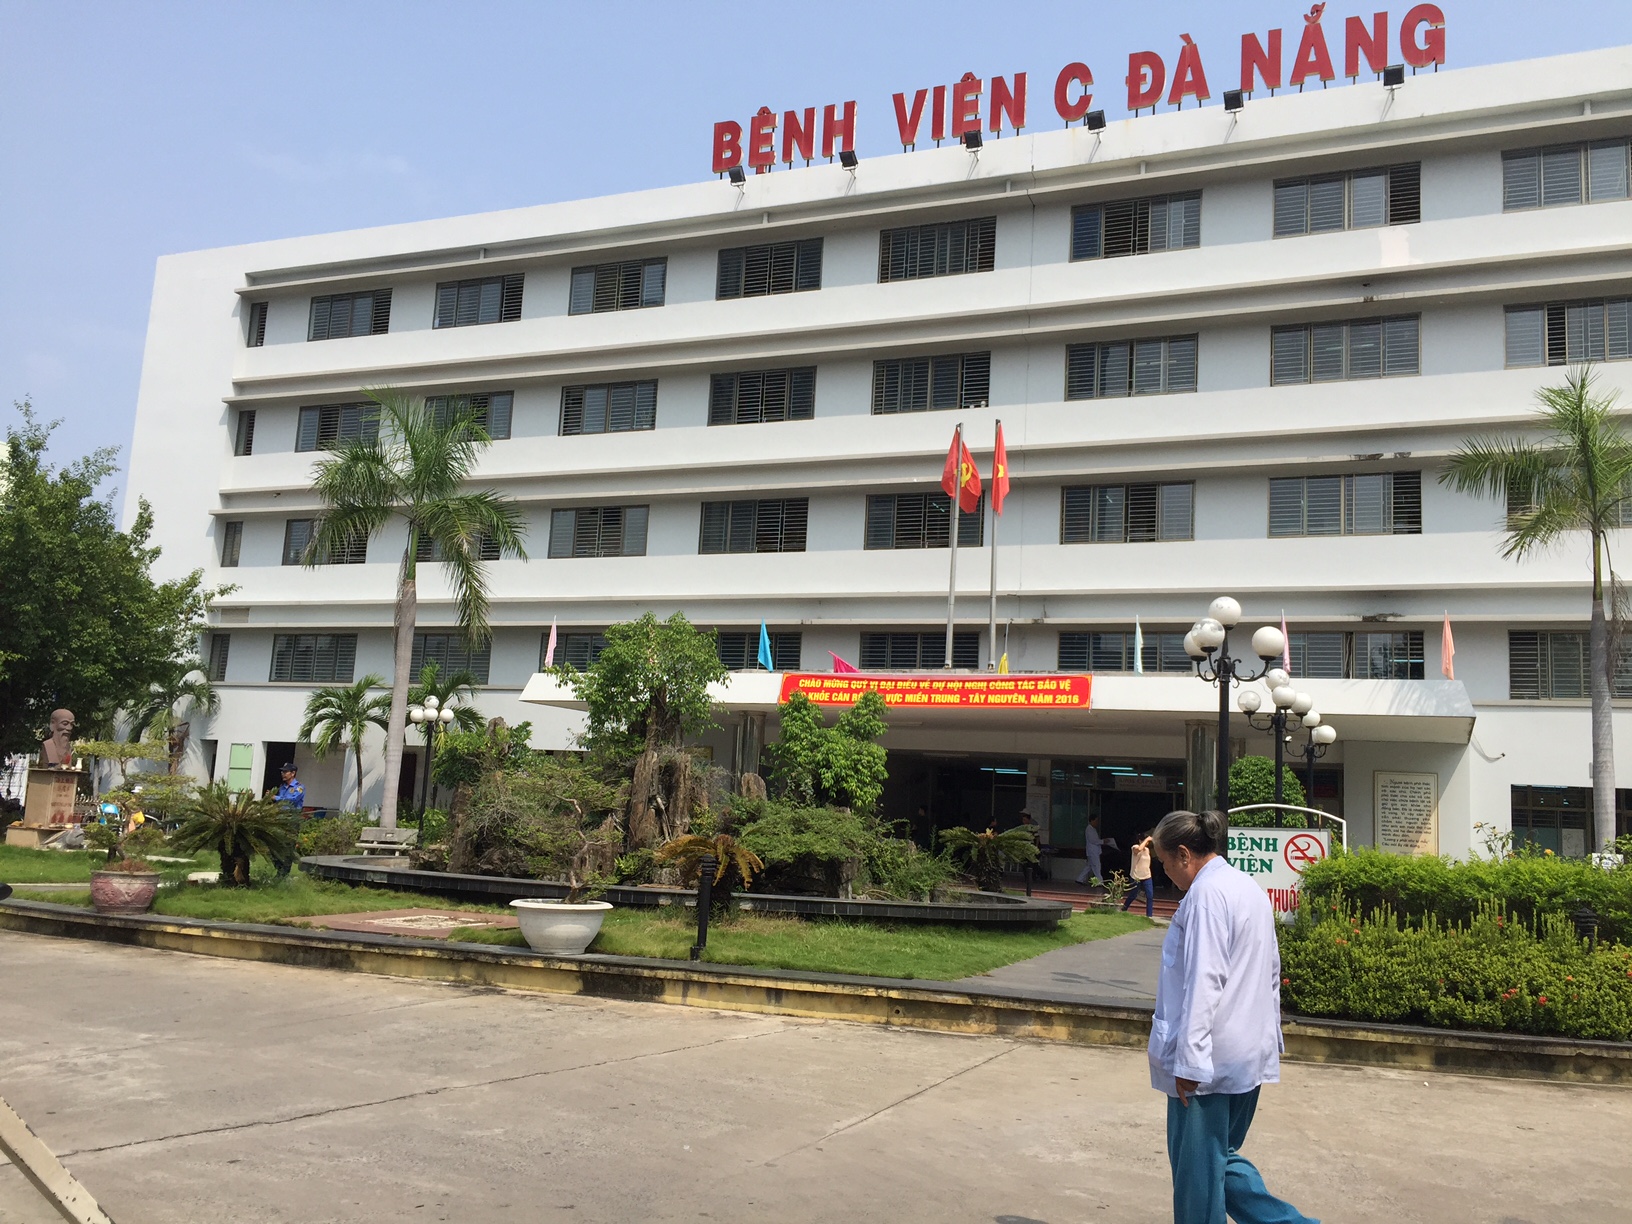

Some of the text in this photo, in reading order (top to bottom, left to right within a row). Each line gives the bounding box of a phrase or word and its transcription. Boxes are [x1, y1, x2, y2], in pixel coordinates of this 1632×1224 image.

[1054, 62, 1094, 122] C
[1125, 33, 1211, 111] ĐÀ
[1241, 2, 1446, 93] NẴNG
[799, 679, 822, 688] CHÀO
[823, 679, 849, 689] MỪNG
[850, 680, 868, 689] QUÝ
[870, 681, 879, 691] VỊ
[879, 681, 895, 691] ĐẠI
[919, 679, 931, 689] VỀ
[932, 682, 945, 691] DỰ
[947, 681, 962, 692] HỘI
[965, 681, 988, 692] NGHỊ
[989, 681, 1015, 690] CÔNG
[1016, 680, 1036, 690] TÁC
[1059, 679, 1072, 692] VỆ
[808, 690, 830, 701] KHỎE
[832, 691, 851, 702] CÁN
[885, 692, 903, 705] VỰC
[905, 691, 929, 703] MIỀN
[930, 694, 960, 703] TRUNG
[968, 693, 986, 703] TÂY
[987, 693, 1028, 705] NGUYÊN,
[1030, 693, 1054, 703] NĂM
[1055, 695, 1080, 704] 2016
[1228, 832, 1278, 854] BỆNH
